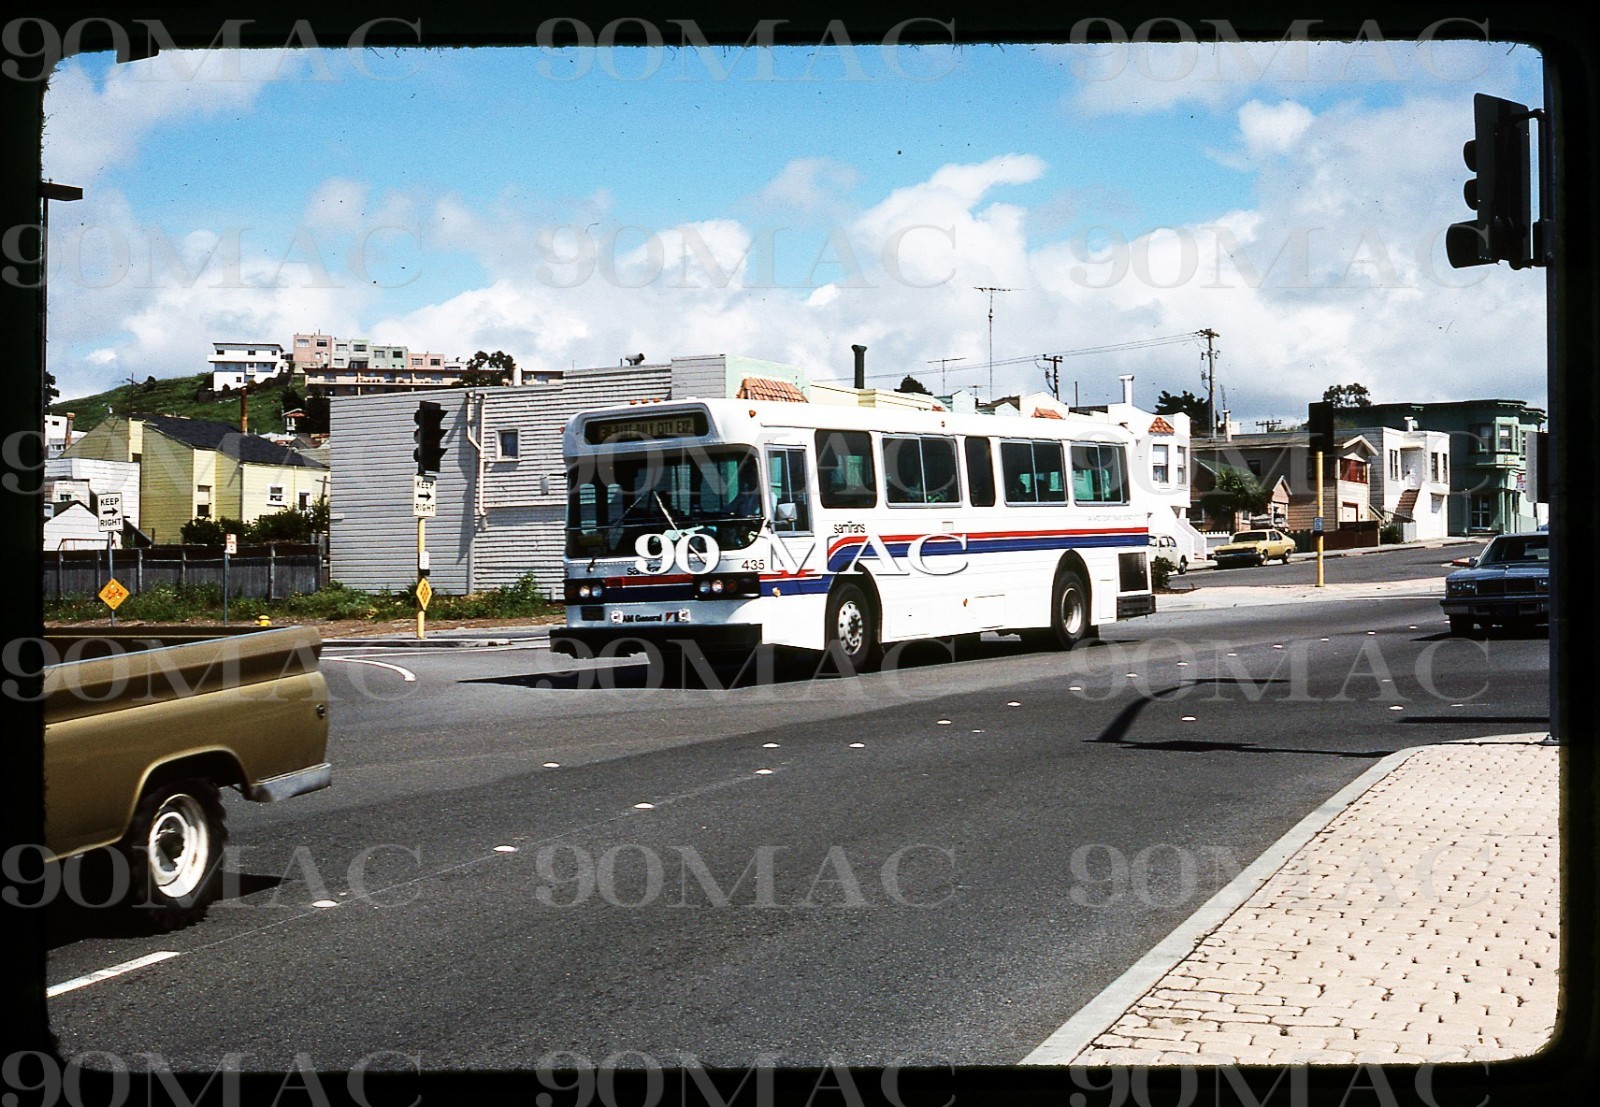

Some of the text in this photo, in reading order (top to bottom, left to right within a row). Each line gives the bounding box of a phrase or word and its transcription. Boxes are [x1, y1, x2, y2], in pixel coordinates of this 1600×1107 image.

[416, 480, 434, 489] KEEP
[100, 497, 119, 506] KEEP
[415, 503, 435, 512] RIGHT
[100, 517, 121, 527] RIGHT
[741, 559, 765, 571] 435
[623, 613, 663, 623] AM General
